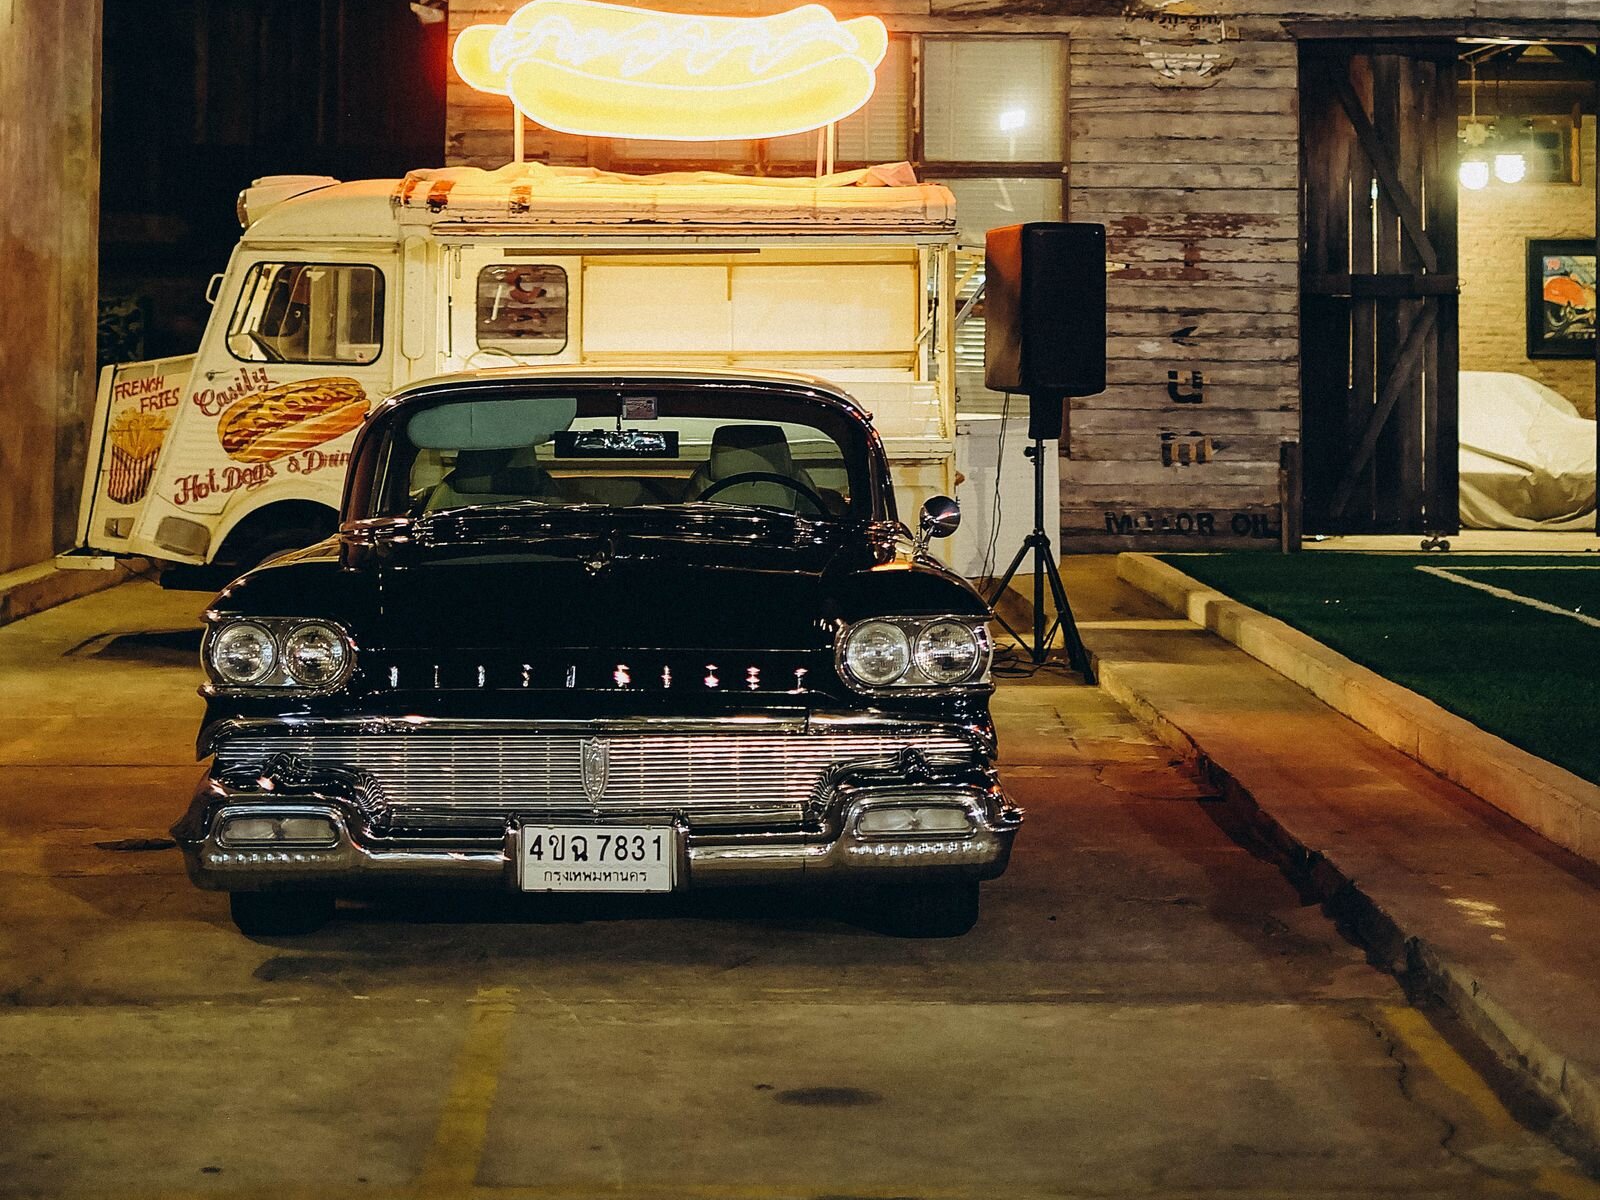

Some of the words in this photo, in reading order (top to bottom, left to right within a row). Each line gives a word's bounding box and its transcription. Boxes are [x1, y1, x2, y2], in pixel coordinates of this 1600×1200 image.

[113, 375, 165, 403] FRENCH
[139, 388, 180, 414] FRIES
[174, 468, 220, 506] Hot
[221, 463, 277, 492] Dogs
[596, 834, 662, 862] 7831
[544, 871, 648, 885] กรุงเทพมหานคร
